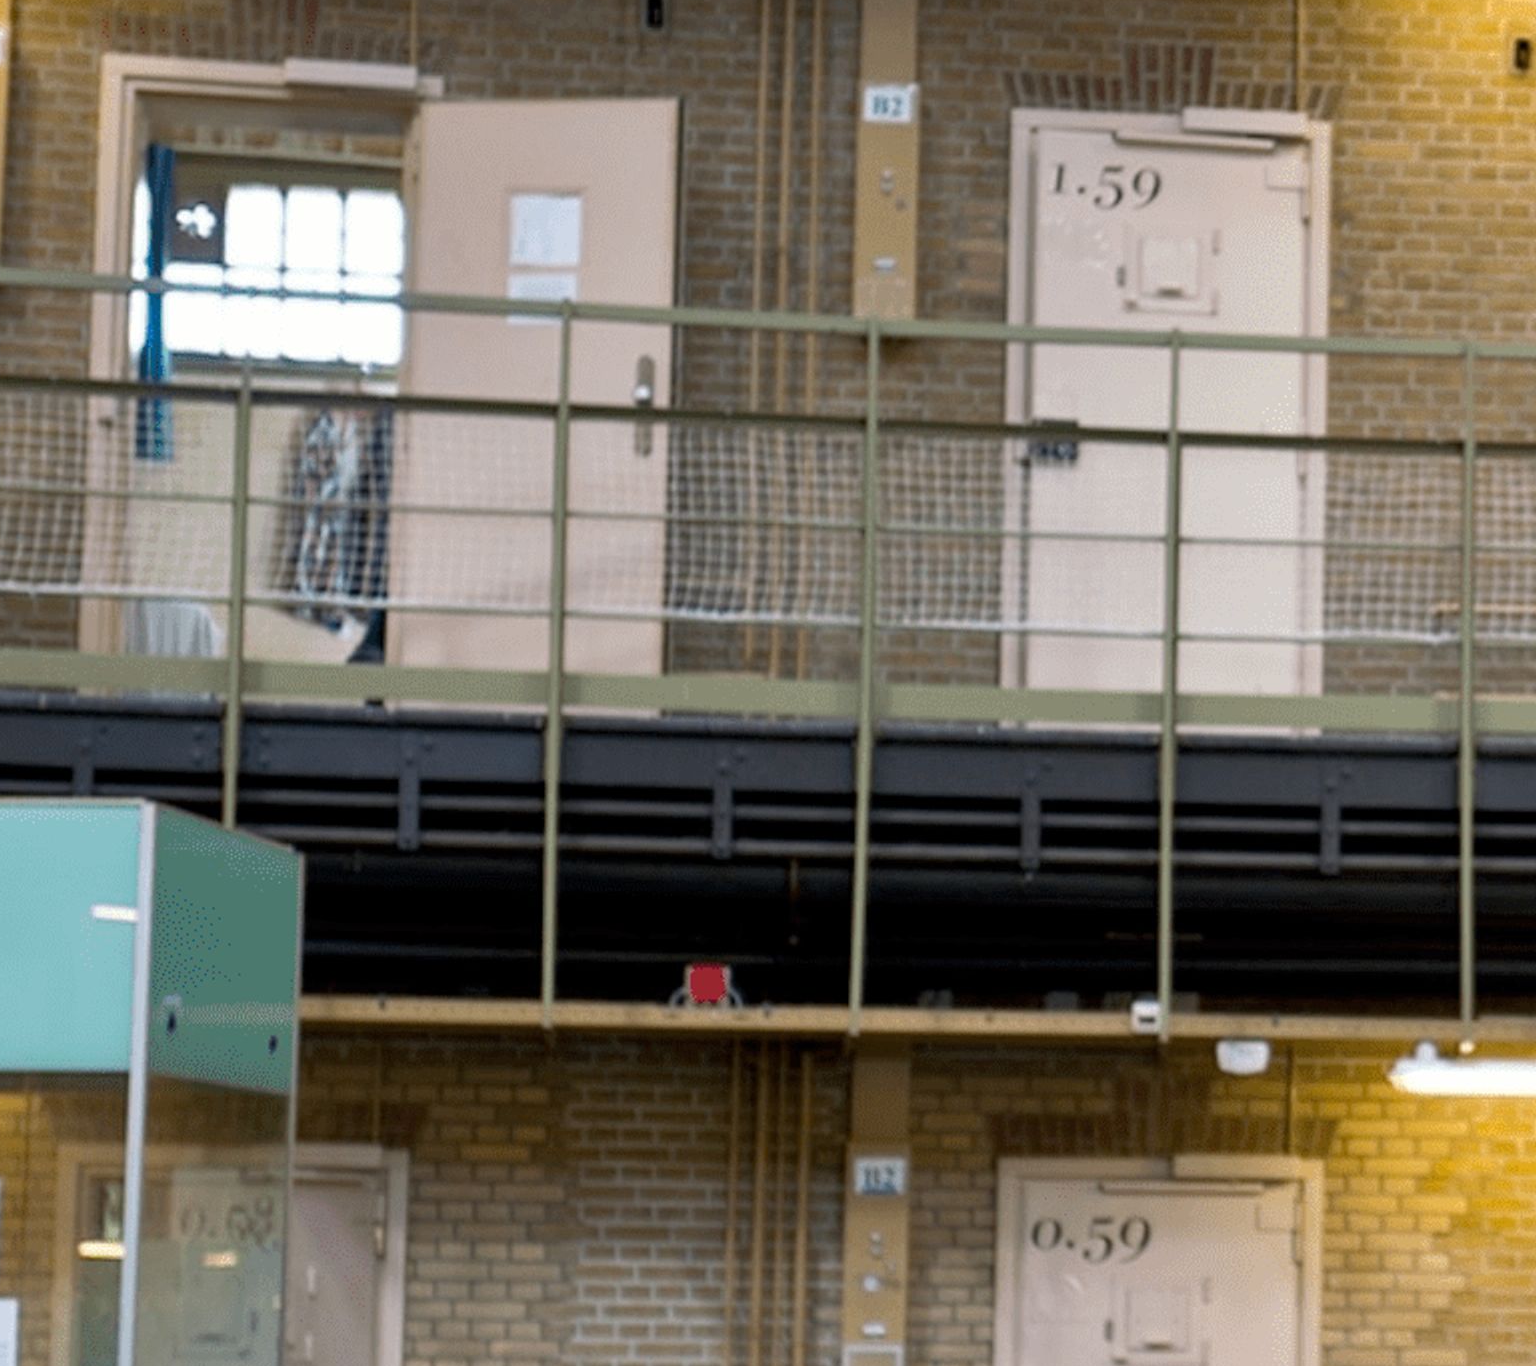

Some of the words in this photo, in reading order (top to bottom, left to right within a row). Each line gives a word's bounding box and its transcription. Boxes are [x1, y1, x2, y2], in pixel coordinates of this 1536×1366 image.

[872, 94, 902, 116] B2
[1052, 163, 1162, 211] 1.59
[1029, 1216, 1152, 1264] 0.59
